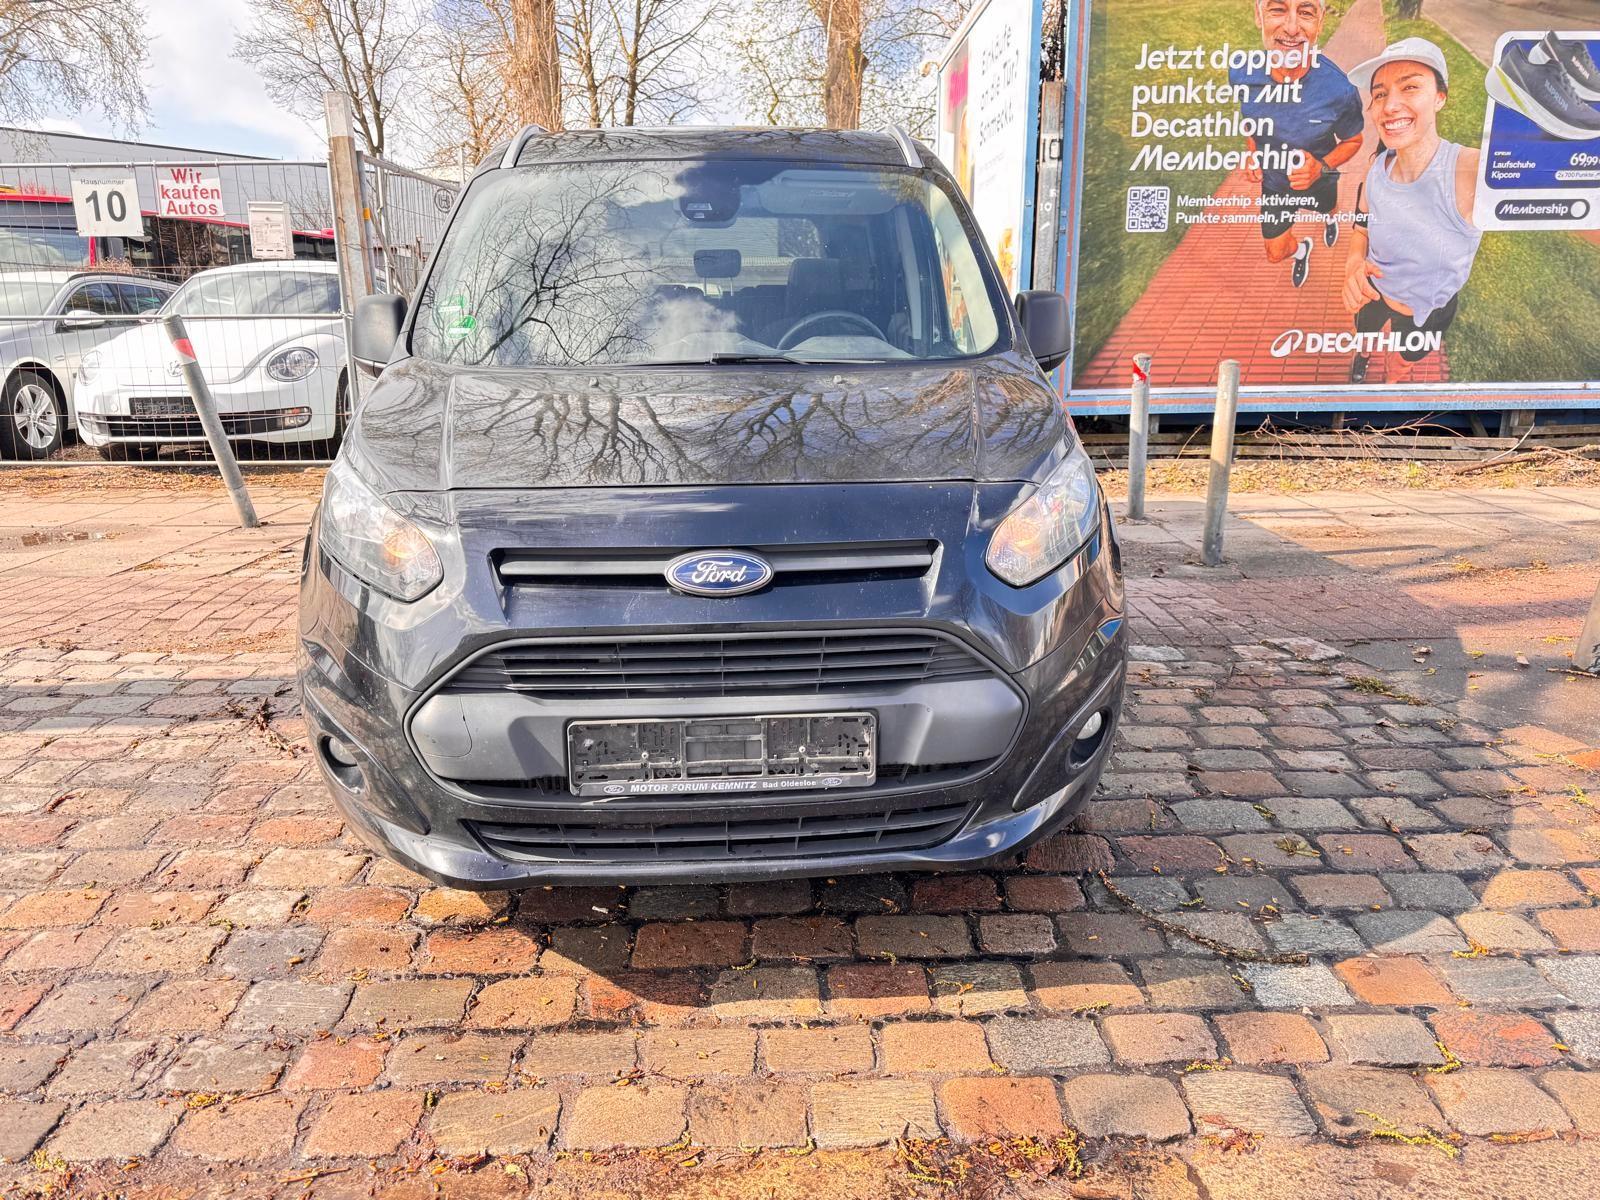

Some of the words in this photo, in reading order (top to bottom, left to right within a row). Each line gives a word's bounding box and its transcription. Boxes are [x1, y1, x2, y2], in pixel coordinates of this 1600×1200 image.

[1134, 43, 1206, 70] Jetzt
[1210, 42, 1321, 76] doppelt
[1132, 77, 1250, 110] punkten
[1131, 111, 1274, 138] Decathlon
[1129, 143, 1306, 176] Membership
[1492, 161, 1536, 169] Laufschuhe
[1569, 152, 1600, 168] 69,99
[171, 168, 202, 184] Wir
[1491, 170, 1521, 180] Kipcore
[161, 184, 220, 200] kaufen
[85, 190, 127, 222] 10
[166, 201, 218, 215] Autos
[1176, 195, 1251, 209] Membership
[1255, 194, 1319, 208] aktivieren,
[1499, 203, 1569, 216] Membership
[1175, 212, 1220, 224] Punkte
[1221, 212, 1279, 225] sammeln,
[1280, 210, 1330, 223] Prämien
[1332, 210, 1377, 222] sichern.
[1305, 330, 1442, 353] DECATHLON
[691, 560, 747, 584] Ford
[630, 784, 668, 792] MOTOR
[671, 783, 709, 792] FORUM
[711, 781, 757, 791] KEMNITZ
[780, 779, 817, 787] Oldesloe
